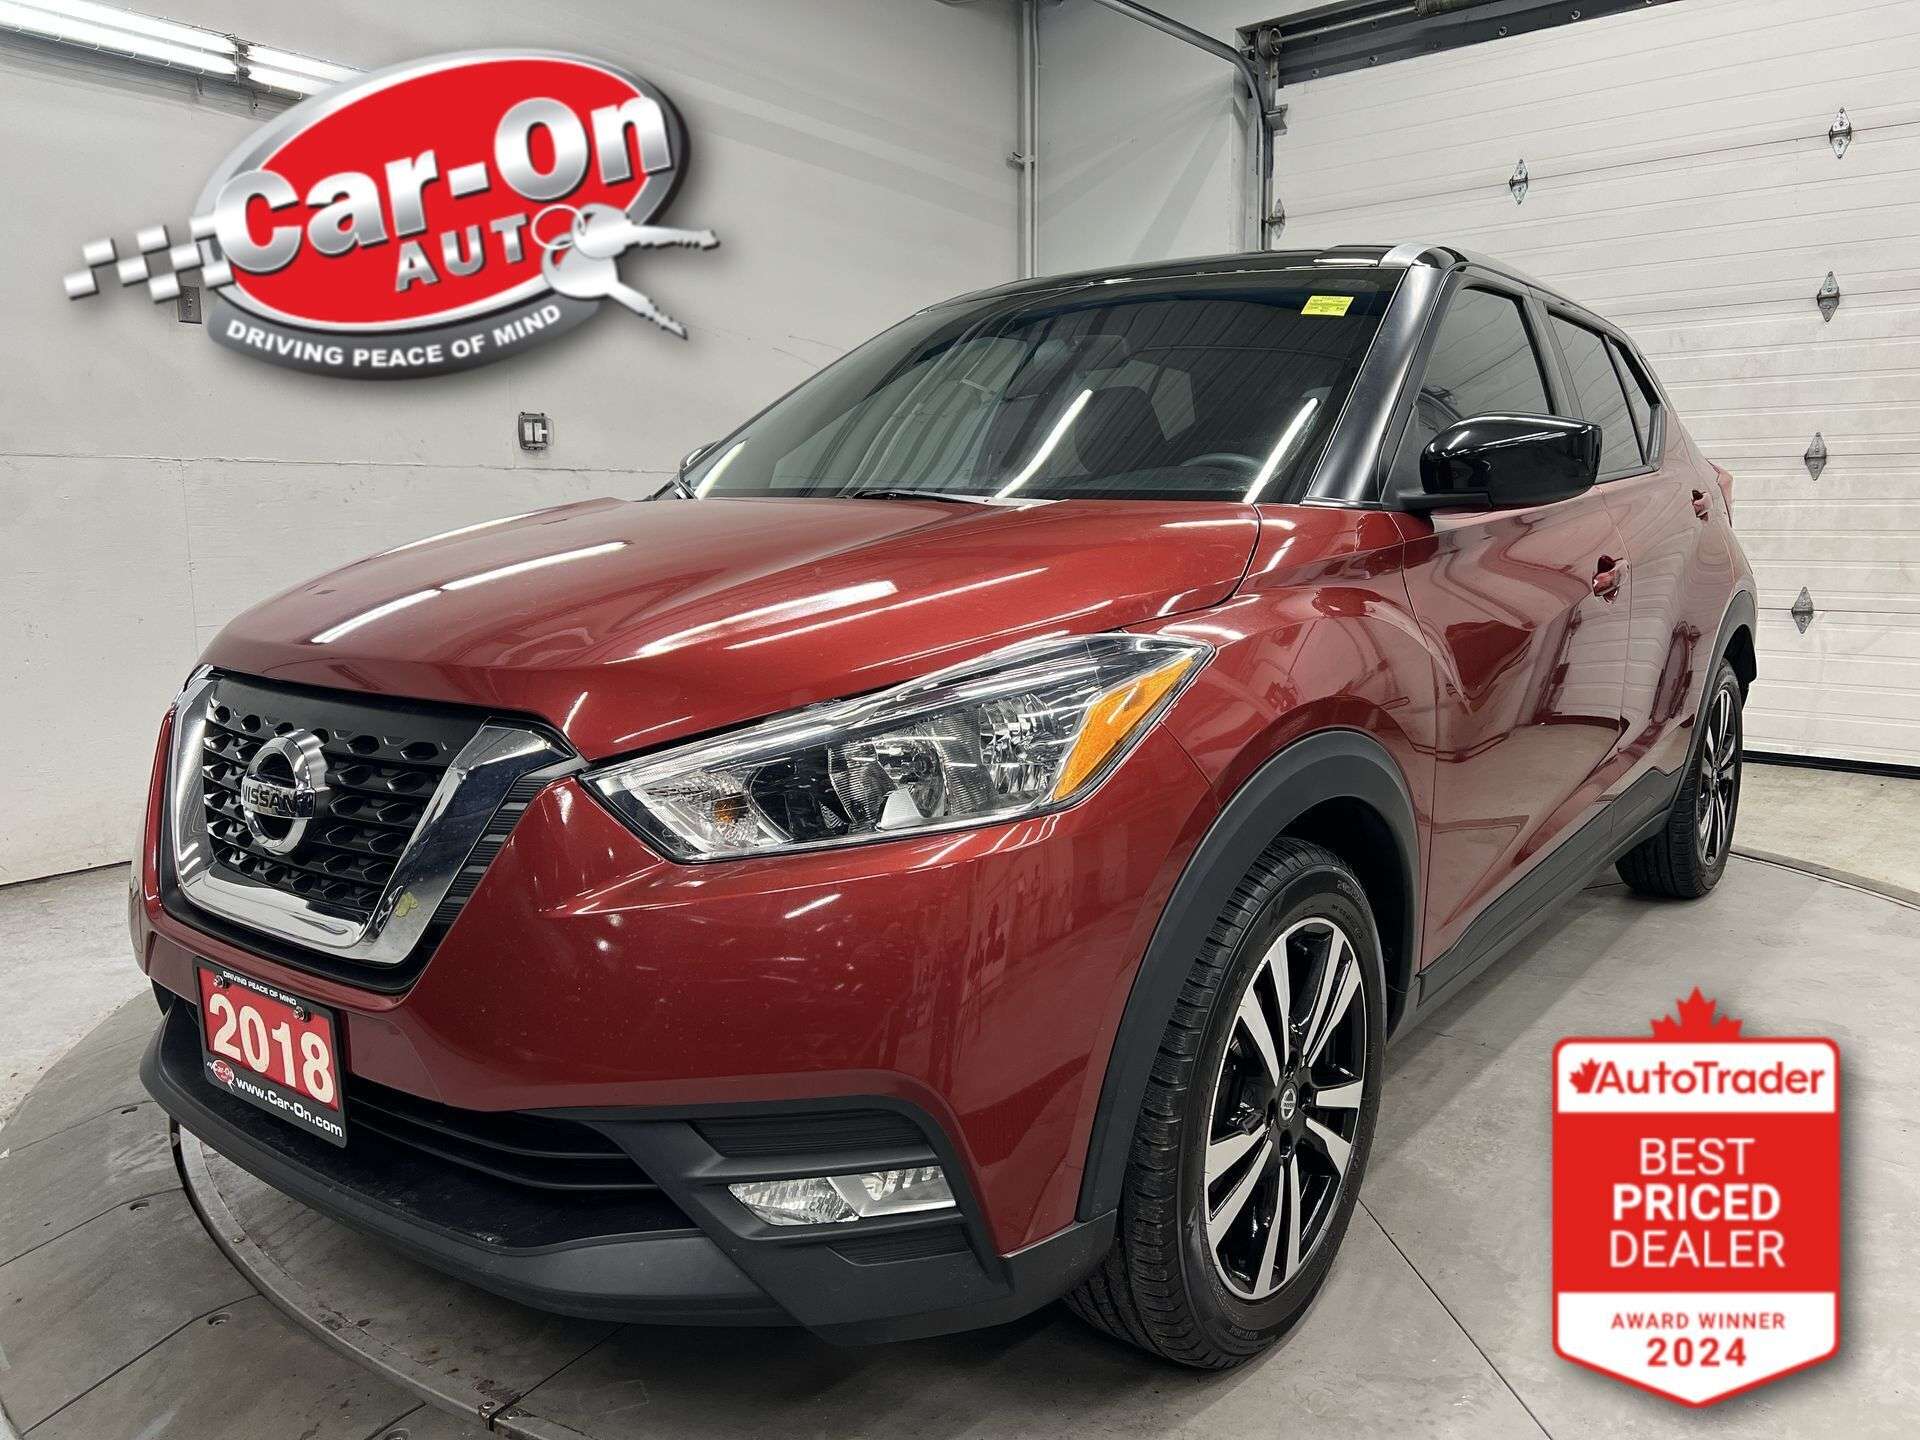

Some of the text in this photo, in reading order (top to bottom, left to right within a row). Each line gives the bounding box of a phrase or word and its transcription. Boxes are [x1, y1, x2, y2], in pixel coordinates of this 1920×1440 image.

[223, 971, 297, 1005] DRIVING PEACE OF MIND
[209, 993, 334, 1104] 2018
[236, 1077, 343, 1137] www.Car-On.com
